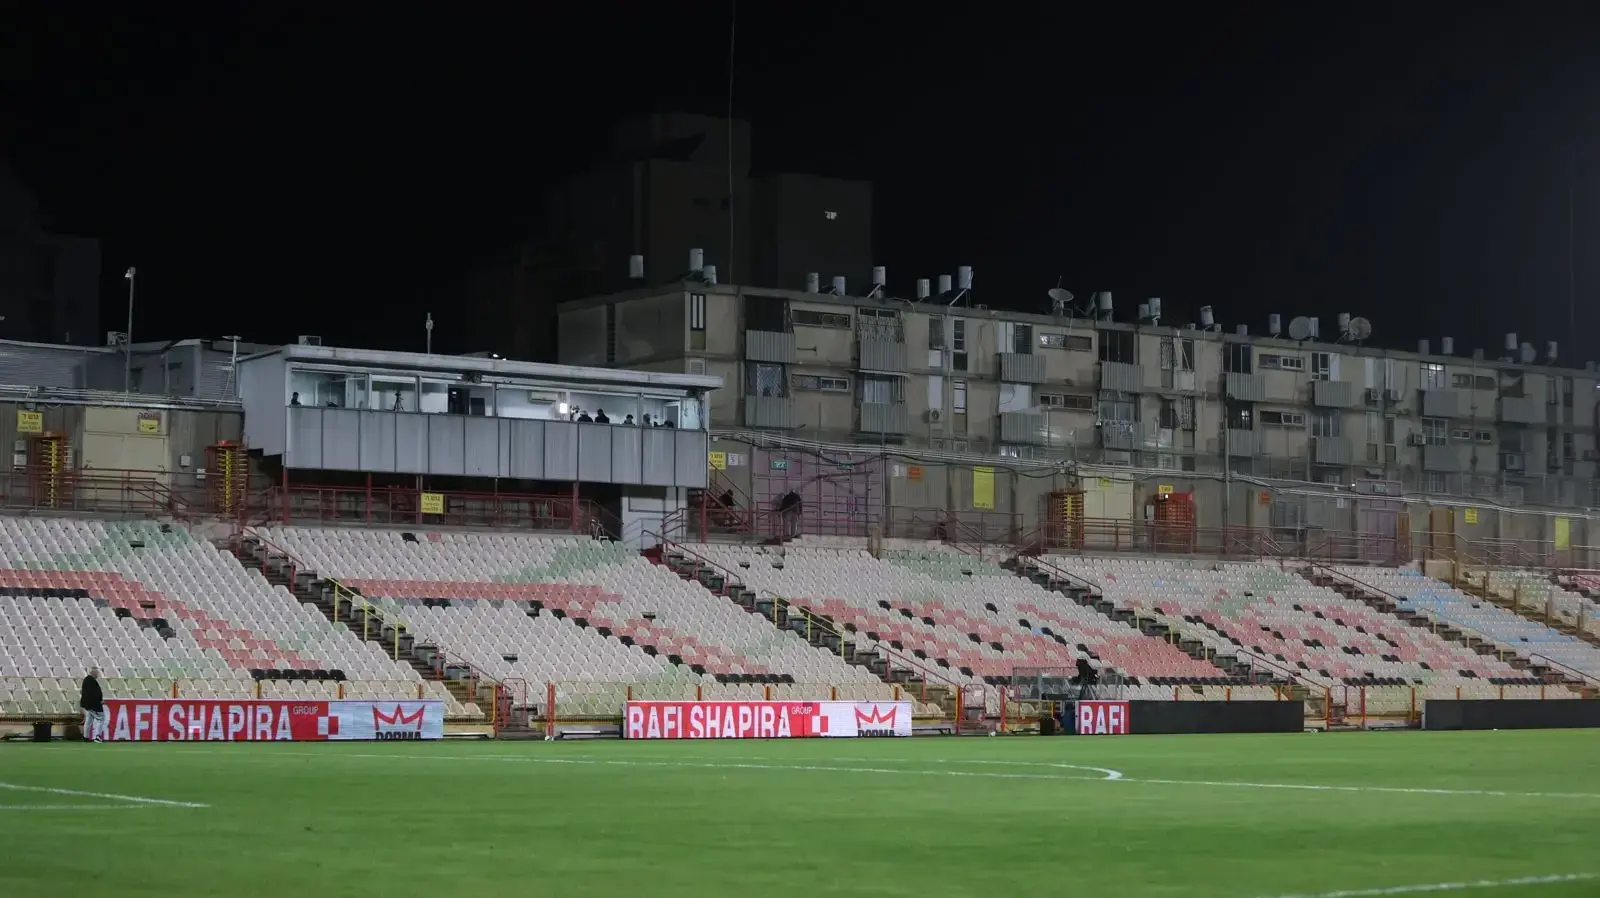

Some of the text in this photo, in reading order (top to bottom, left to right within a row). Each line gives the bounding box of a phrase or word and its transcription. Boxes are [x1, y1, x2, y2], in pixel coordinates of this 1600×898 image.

[168, 704, 292, 741] SHAPIRA
[292, 706, 319, 716] GROUP
[629, 705, 791, 738] RAFI SHAPIRA
[790, 706, 813, 715] GROUP
[1080, 705, 1125, 735] RAFI
